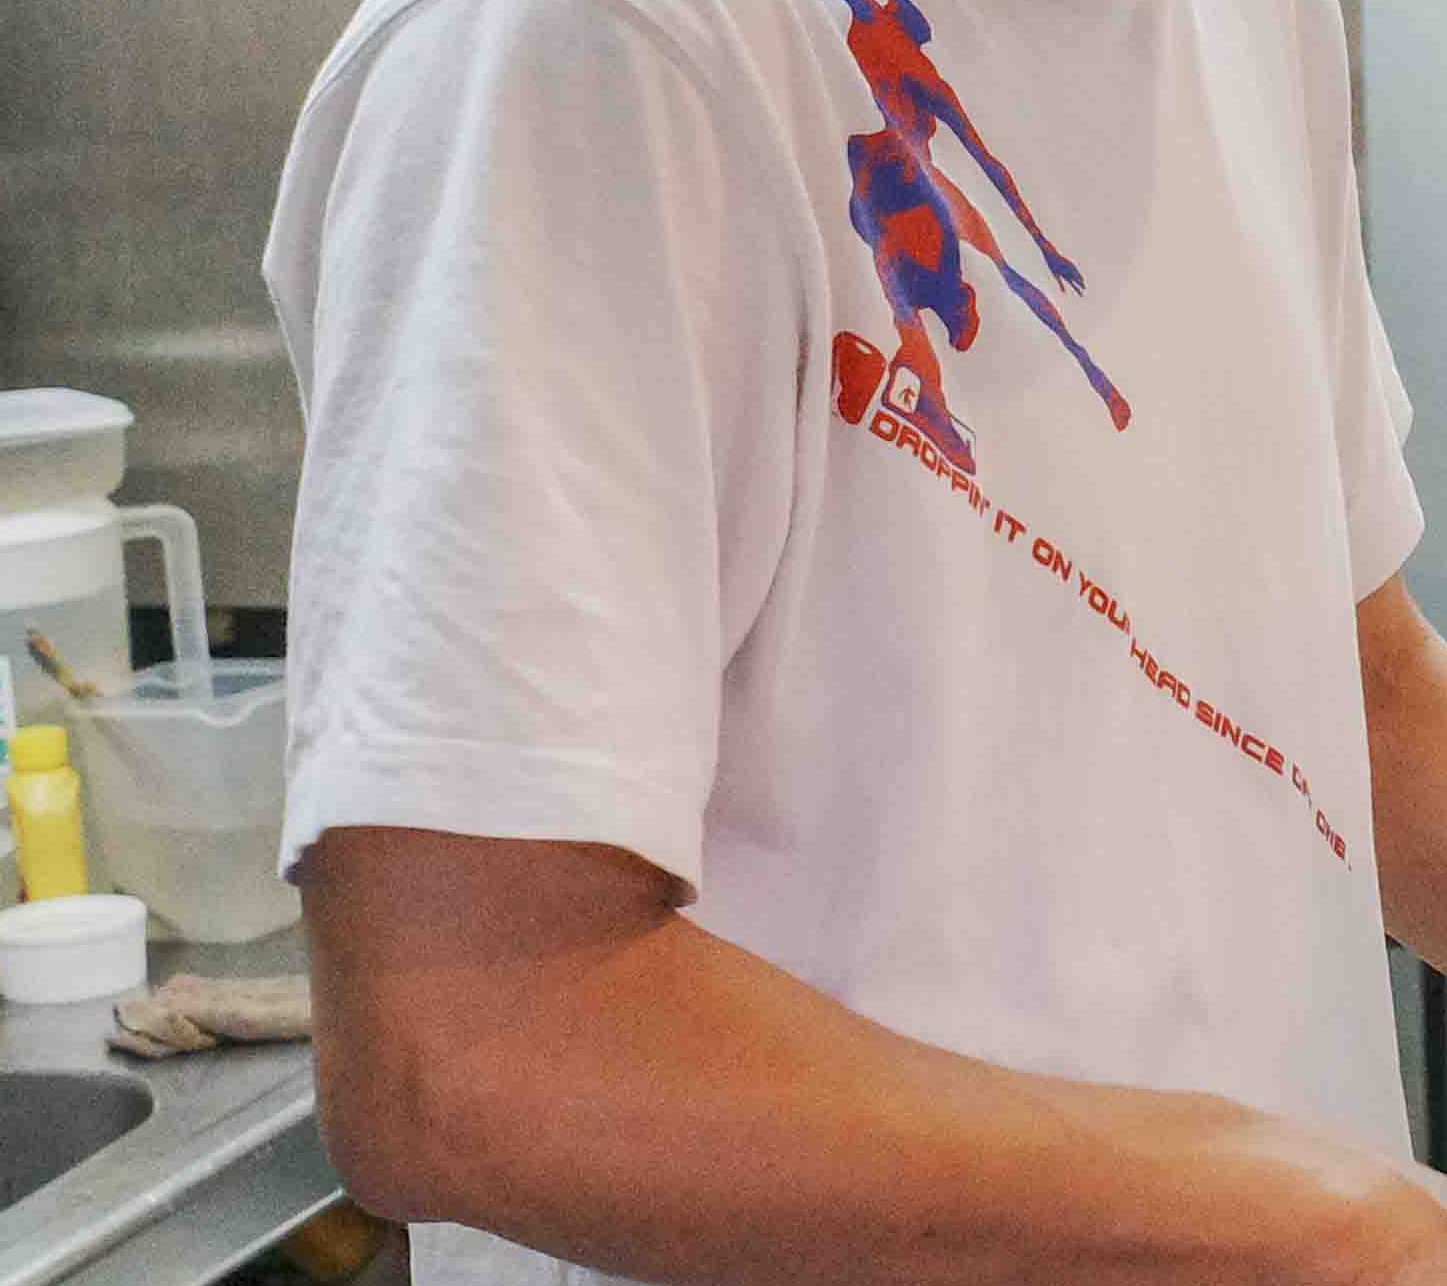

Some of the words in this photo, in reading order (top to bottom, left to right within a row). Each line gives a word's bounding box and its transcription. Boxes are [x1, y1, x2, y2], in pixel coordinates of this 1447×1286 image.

[994, 509, 1027, 543] IT
[1032, 537, 1072, 582] ON
[1079, 569, 1130, 634] YOU
[1195, 699, 1285, 777] SINCE
